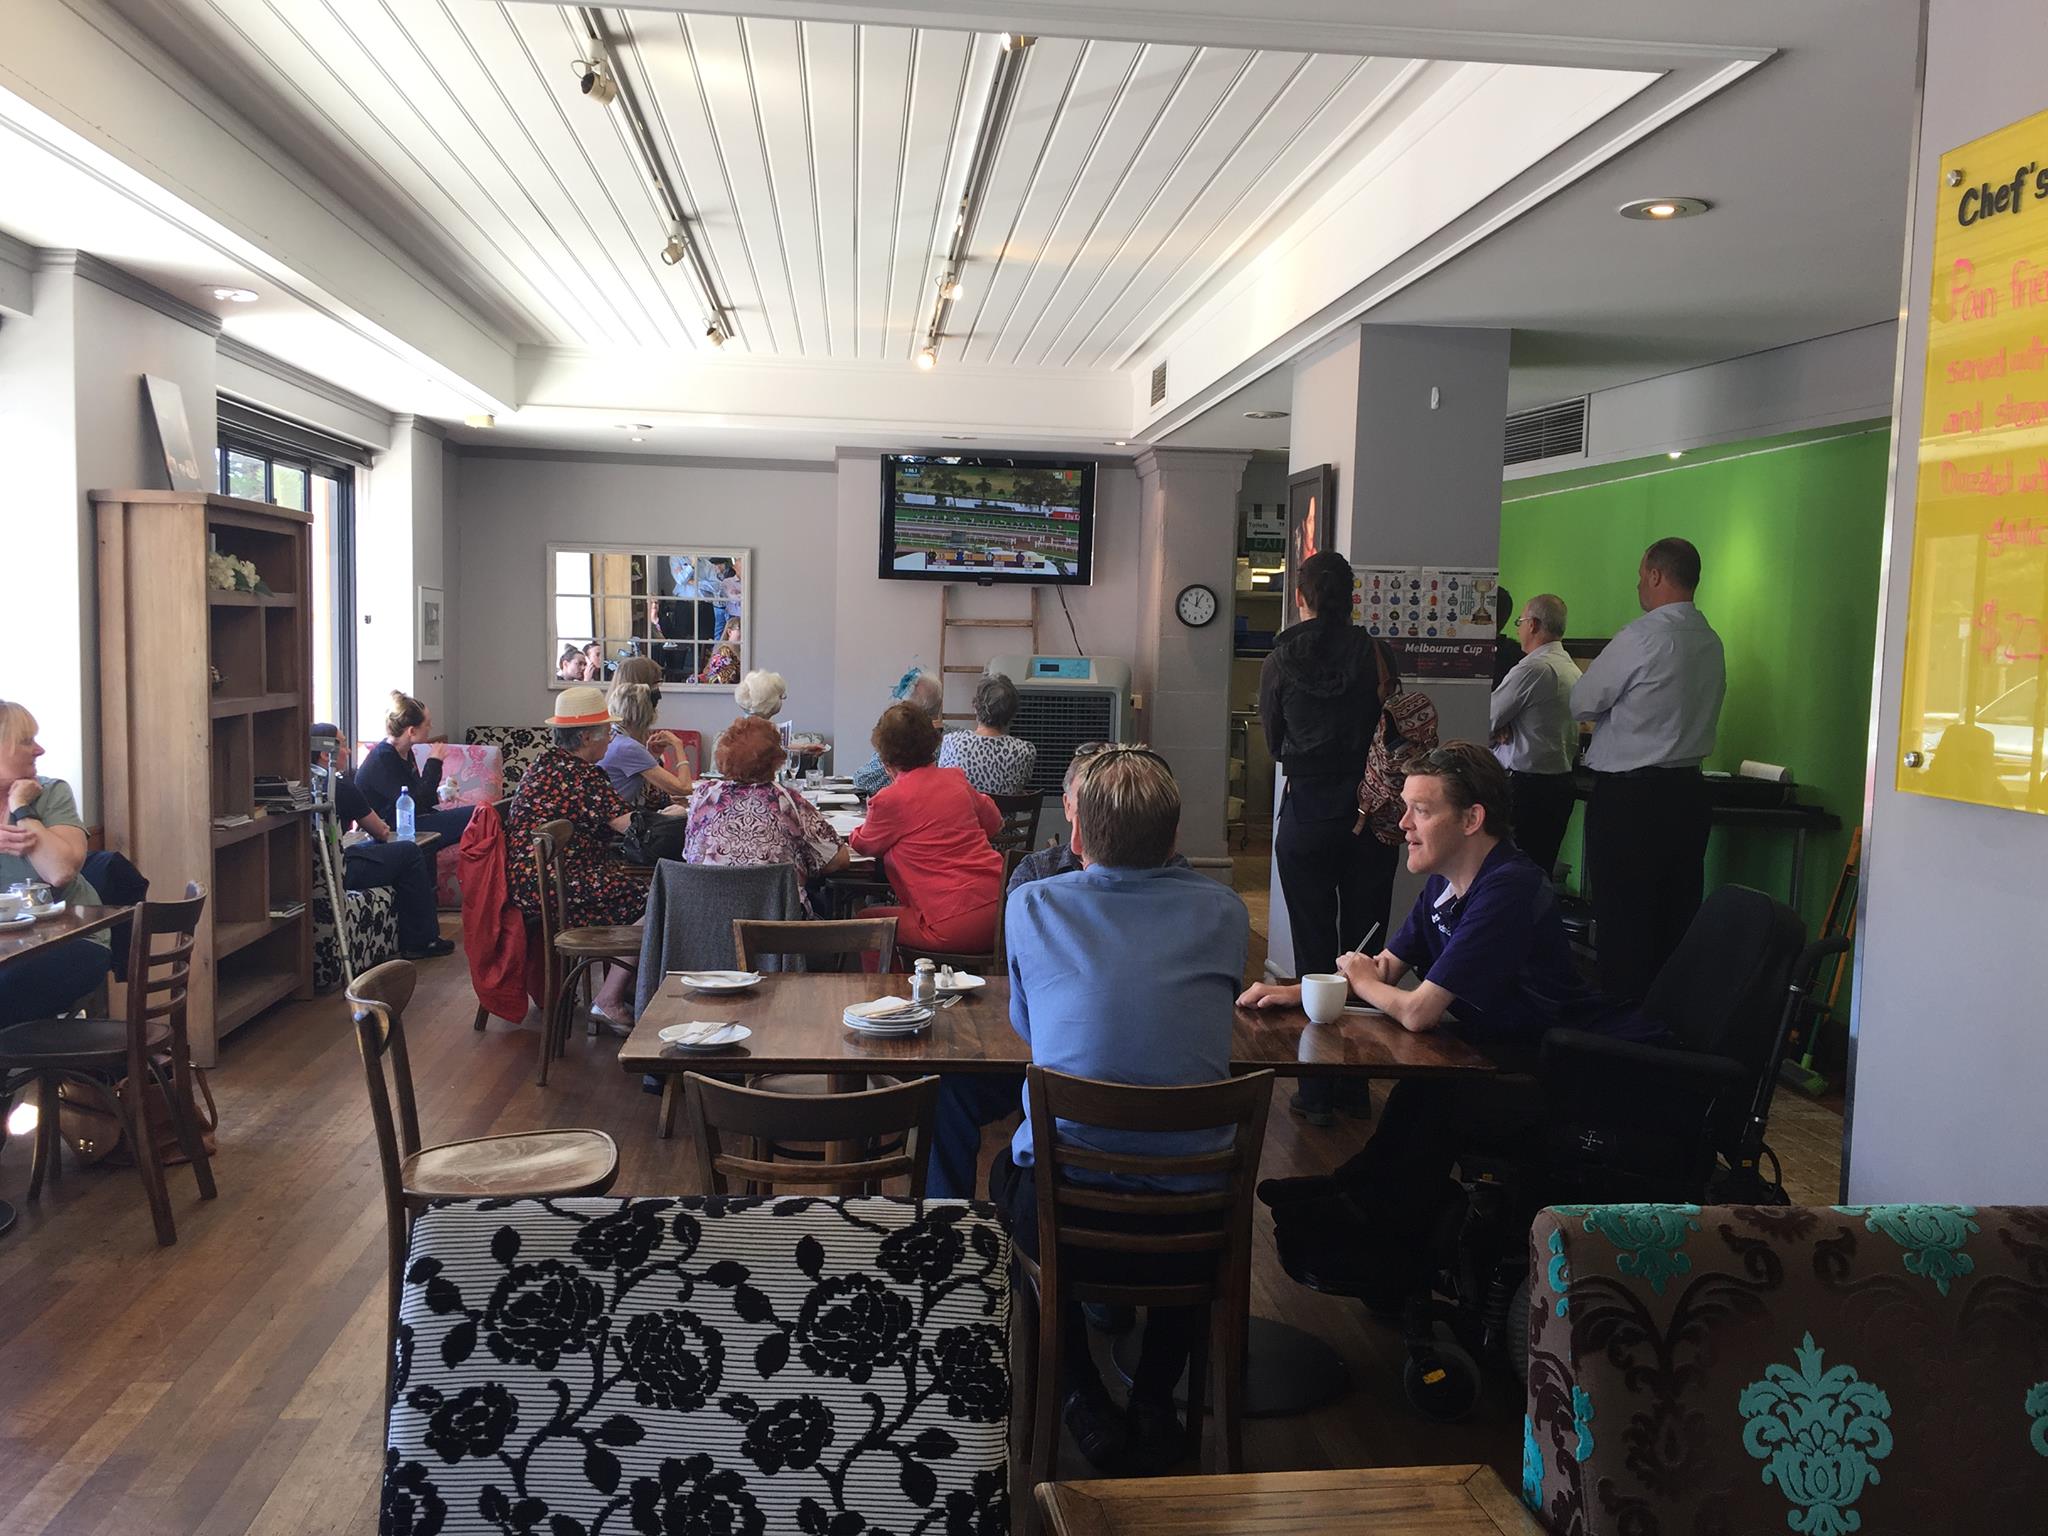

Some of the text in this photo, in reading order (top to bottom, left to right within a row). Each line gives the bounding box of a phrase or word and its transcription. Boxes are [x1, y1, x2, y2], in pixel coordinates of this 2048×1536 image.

[1461, 584, 1474, 600] THE
[1459, 600, 1475, 615] CUP
[1404, 642, 1483, 656] Melbourne Cup
